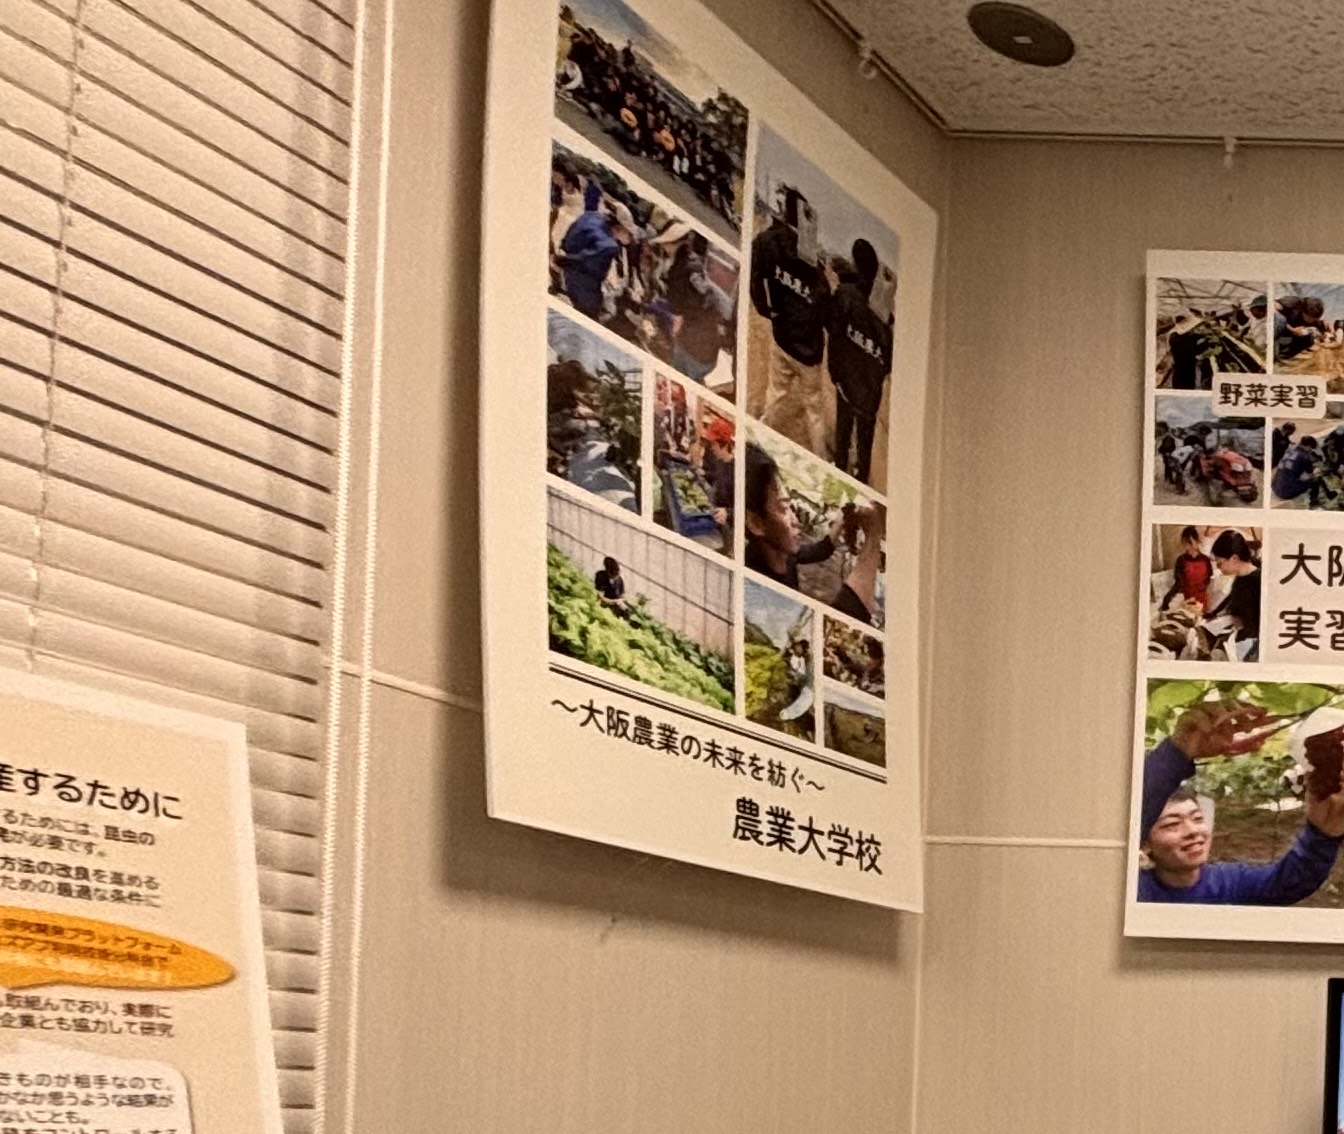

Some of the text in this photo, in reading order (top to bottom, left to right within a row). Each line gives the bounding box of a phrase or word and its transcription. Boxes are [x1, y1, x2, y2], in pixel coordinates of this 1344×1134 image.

[1219, 382, 1319, 409] 野菜実習
[732, 796, 883, 875] 農業大学校
